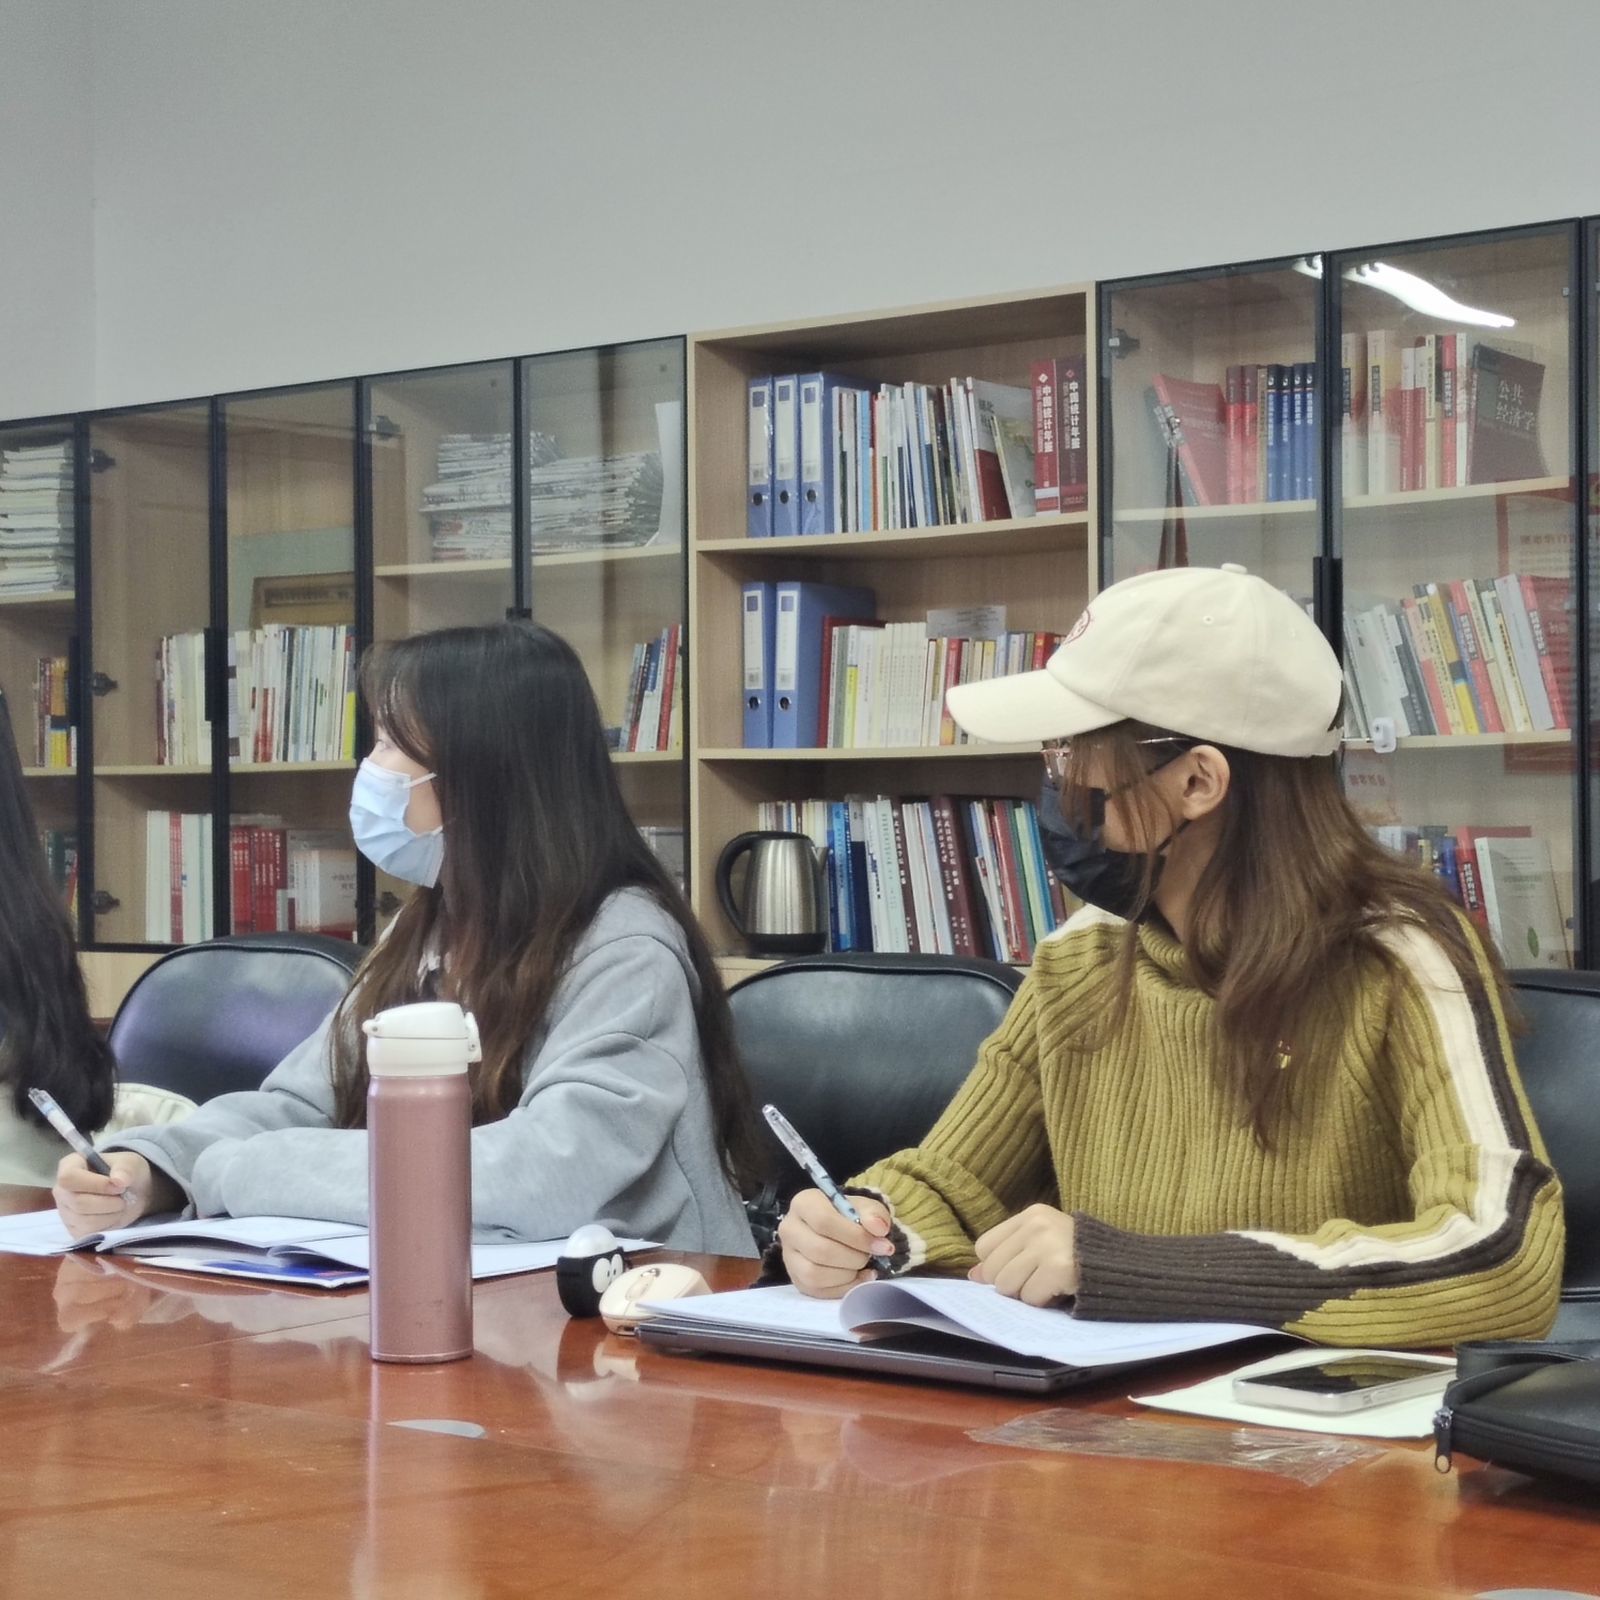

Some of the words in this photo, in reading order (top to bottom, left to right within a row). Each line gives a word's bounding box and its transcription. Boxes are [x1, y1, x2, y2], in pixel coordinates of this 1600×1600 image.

[1042, 384, 1053, 454] 中国统计年鉴
[1069, 381, 1081, 450] 中国统计年鉴
